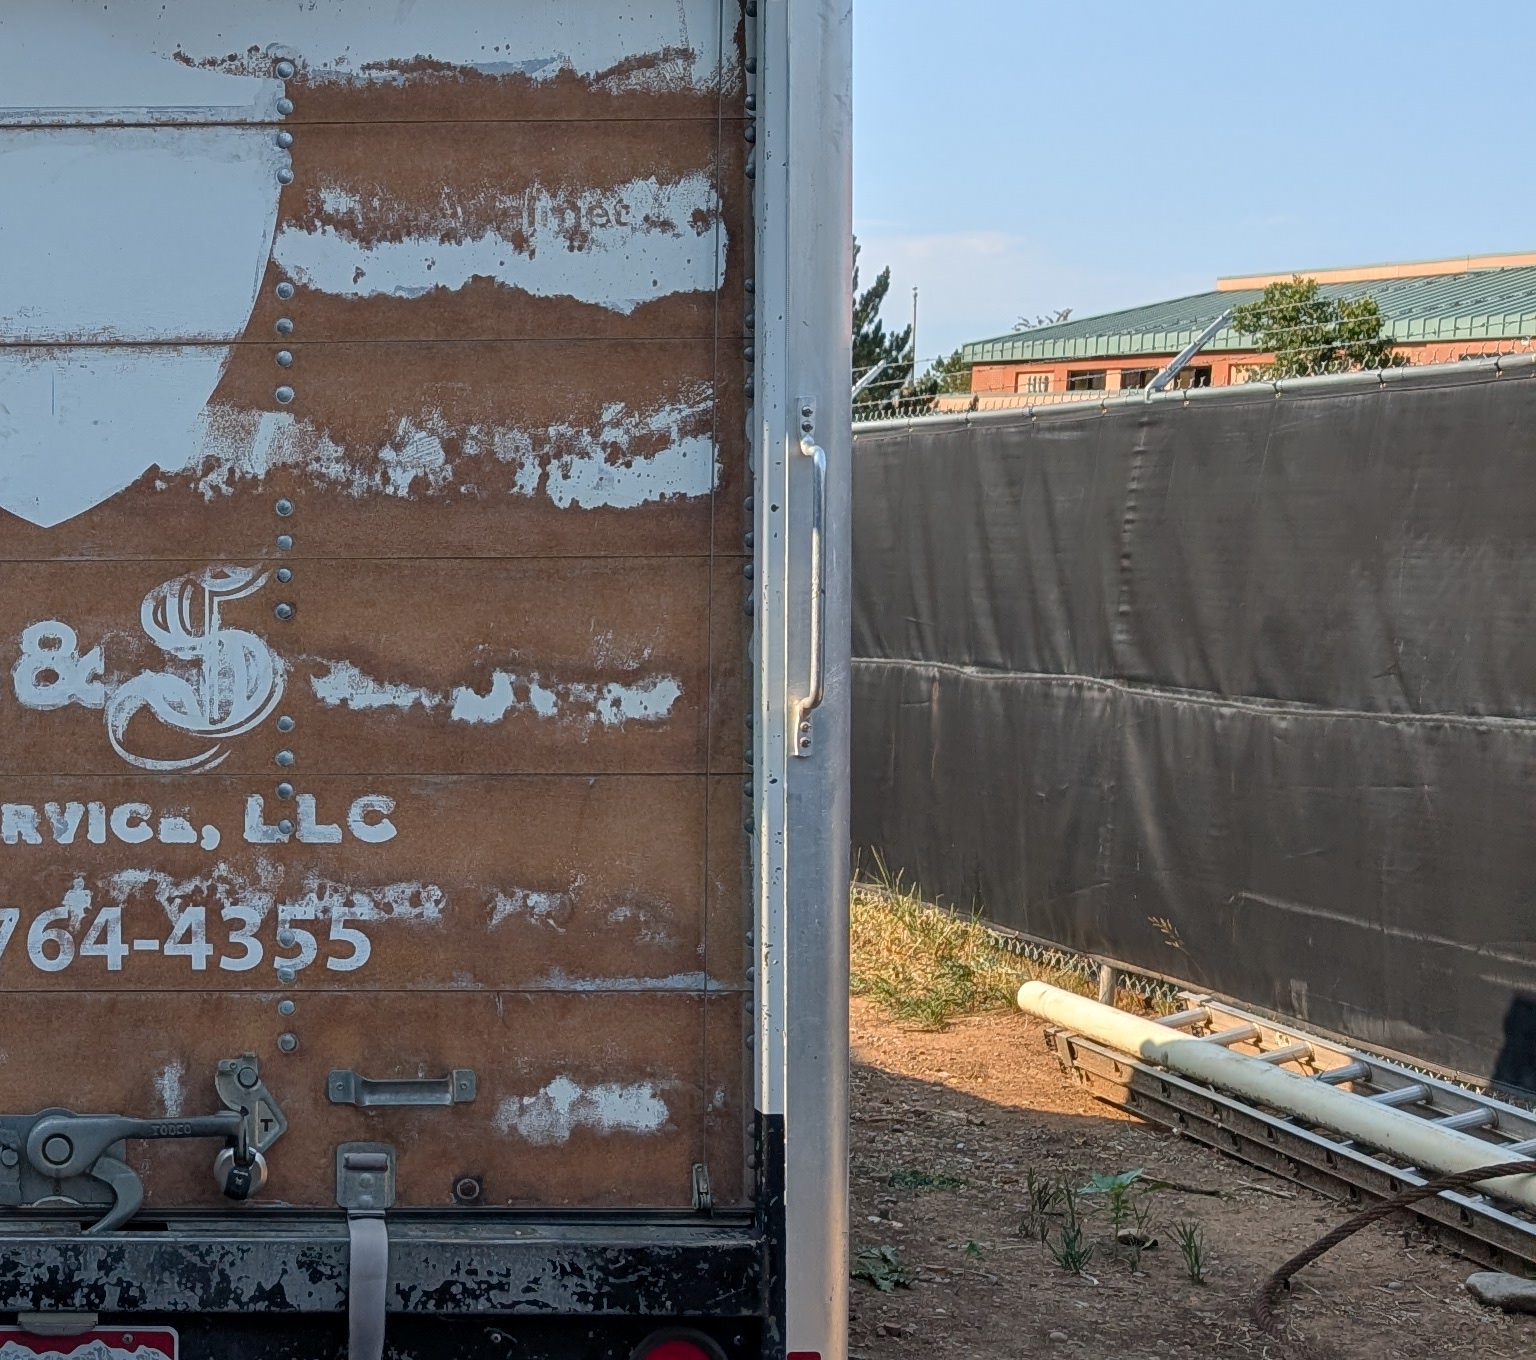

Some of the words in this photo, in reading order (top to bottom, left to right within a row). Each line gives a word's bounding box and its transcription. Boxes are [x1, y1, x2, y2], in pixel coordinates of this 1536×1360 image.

[13, 619, 105, 710] &
[107, 563, 288, 773] S
[242, 793, 398, 845] LLC
